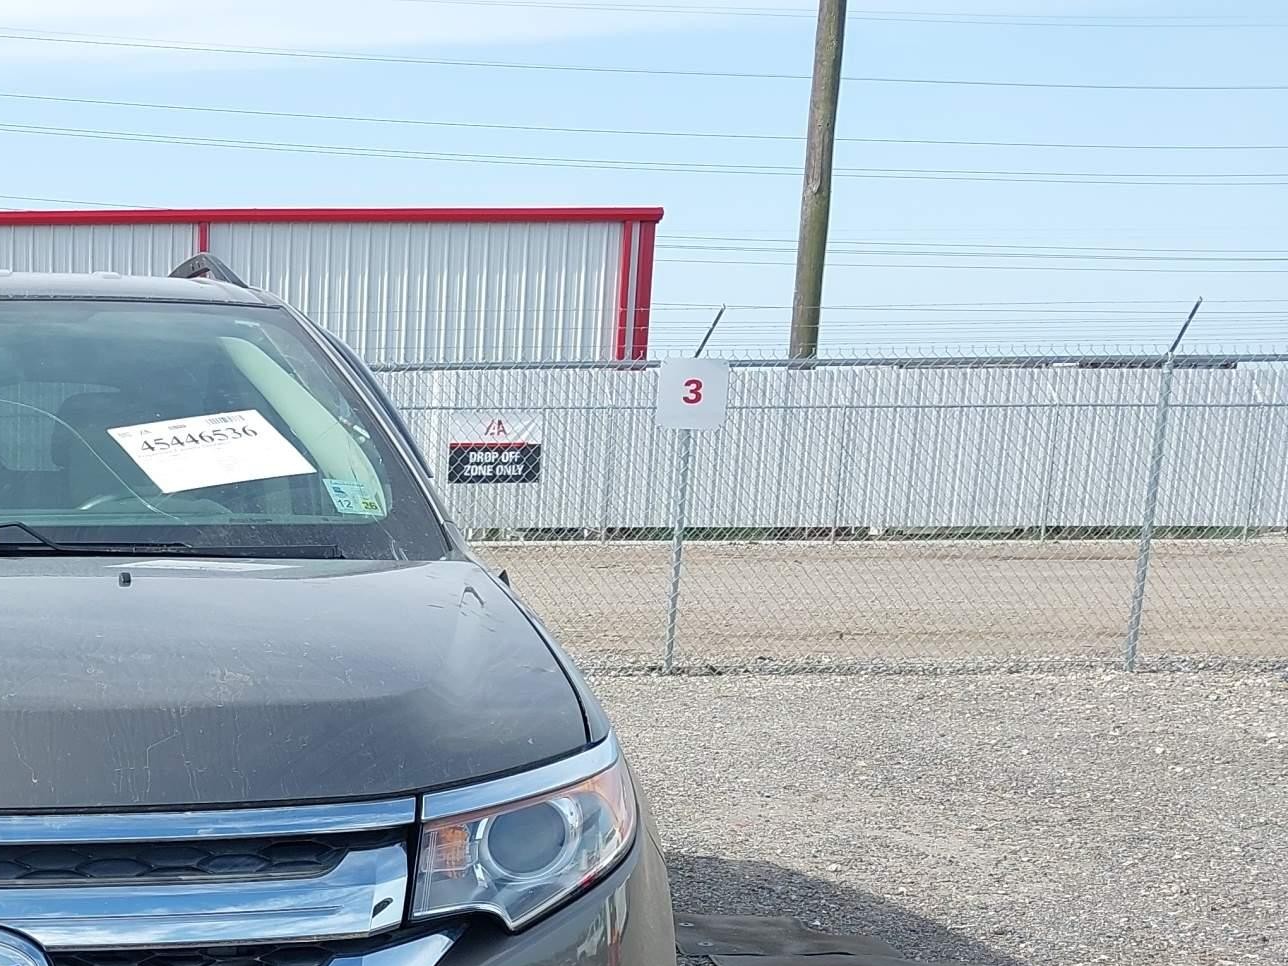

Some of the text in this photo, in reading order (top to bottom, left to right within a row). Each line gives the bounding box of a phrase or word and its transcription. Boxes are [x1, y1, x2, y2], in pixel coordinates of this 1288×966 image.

[682, 379, 703, 404] 3
[141, 424, 258, 452] 45446536
[469, 451, 520, 463] DROP OFF
[463, 464, 524, 476] ZONE ONLY
[338, 499, 353, 509] 12
